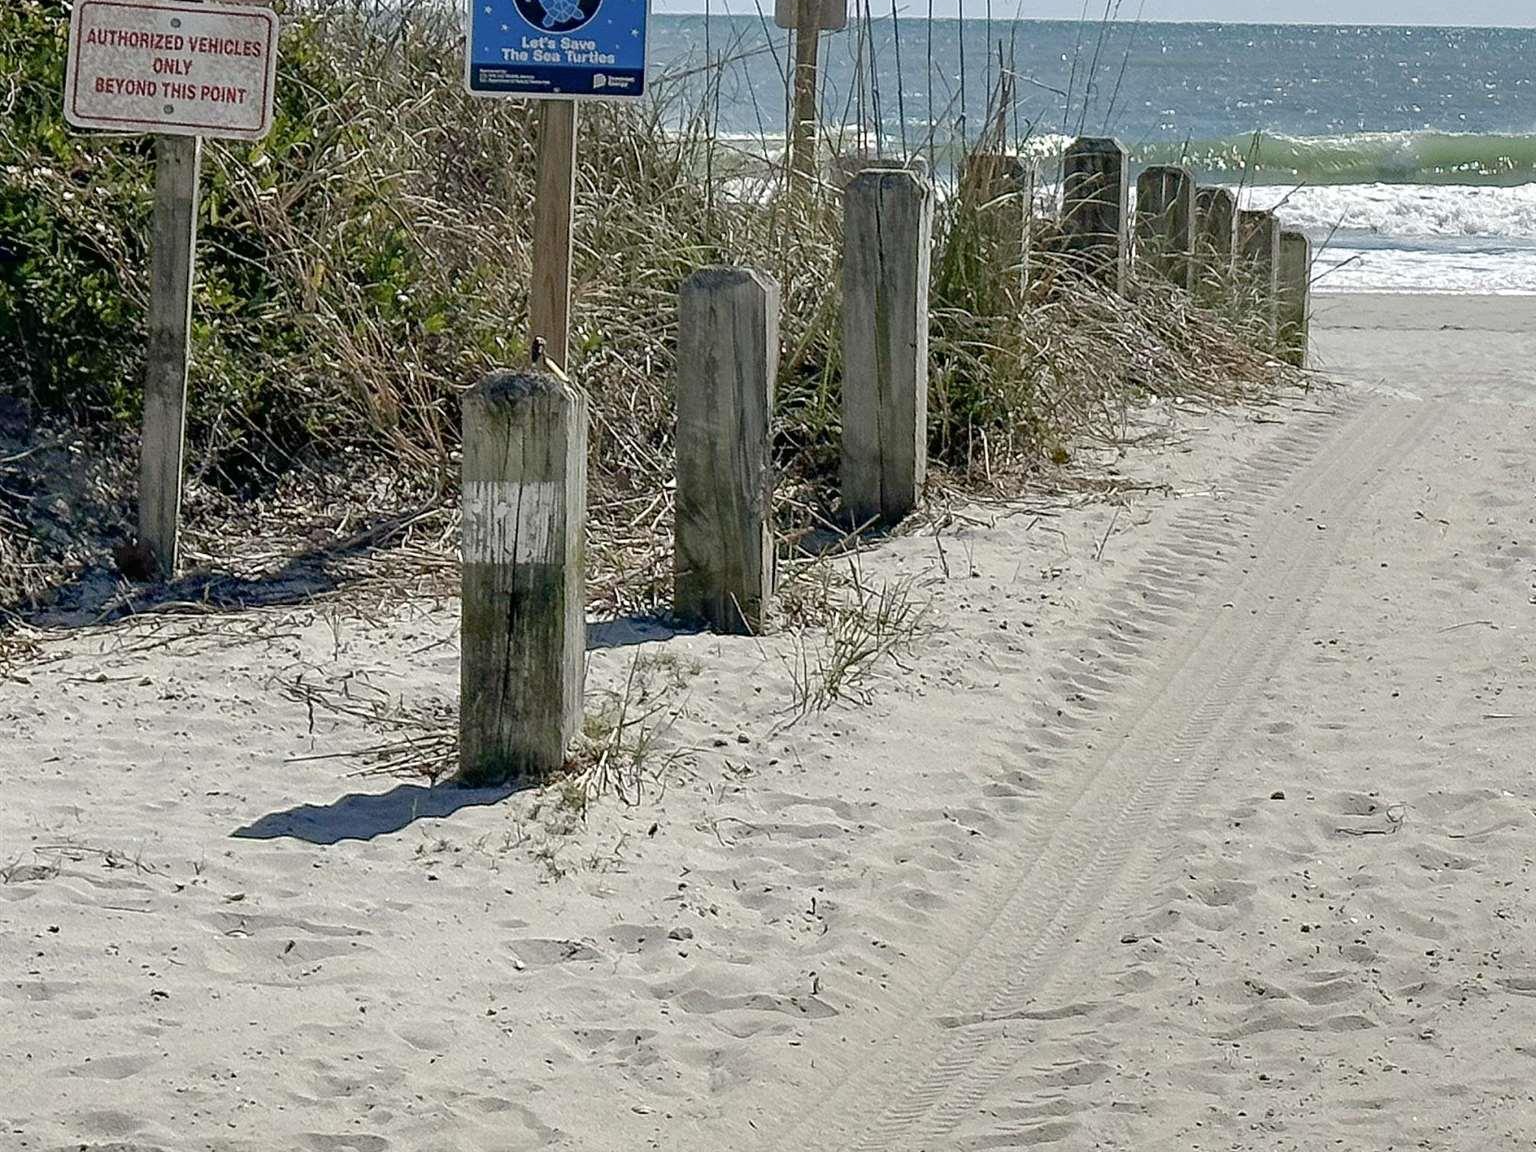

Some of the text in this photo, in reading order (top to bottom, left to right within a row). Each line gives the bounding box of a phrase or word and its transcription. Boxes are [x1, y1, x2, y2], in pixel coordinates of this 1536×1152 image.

[86, 28, 262, 58] AUTHORIZED VEHICLES
[521, 36, 596, 50] Let's Save
[501, 47, 616, 64] The Sea Turtles
[153, 57, 193, 75] ONLY
[95, 77, 248, 104] BEYOND THIS POINT
